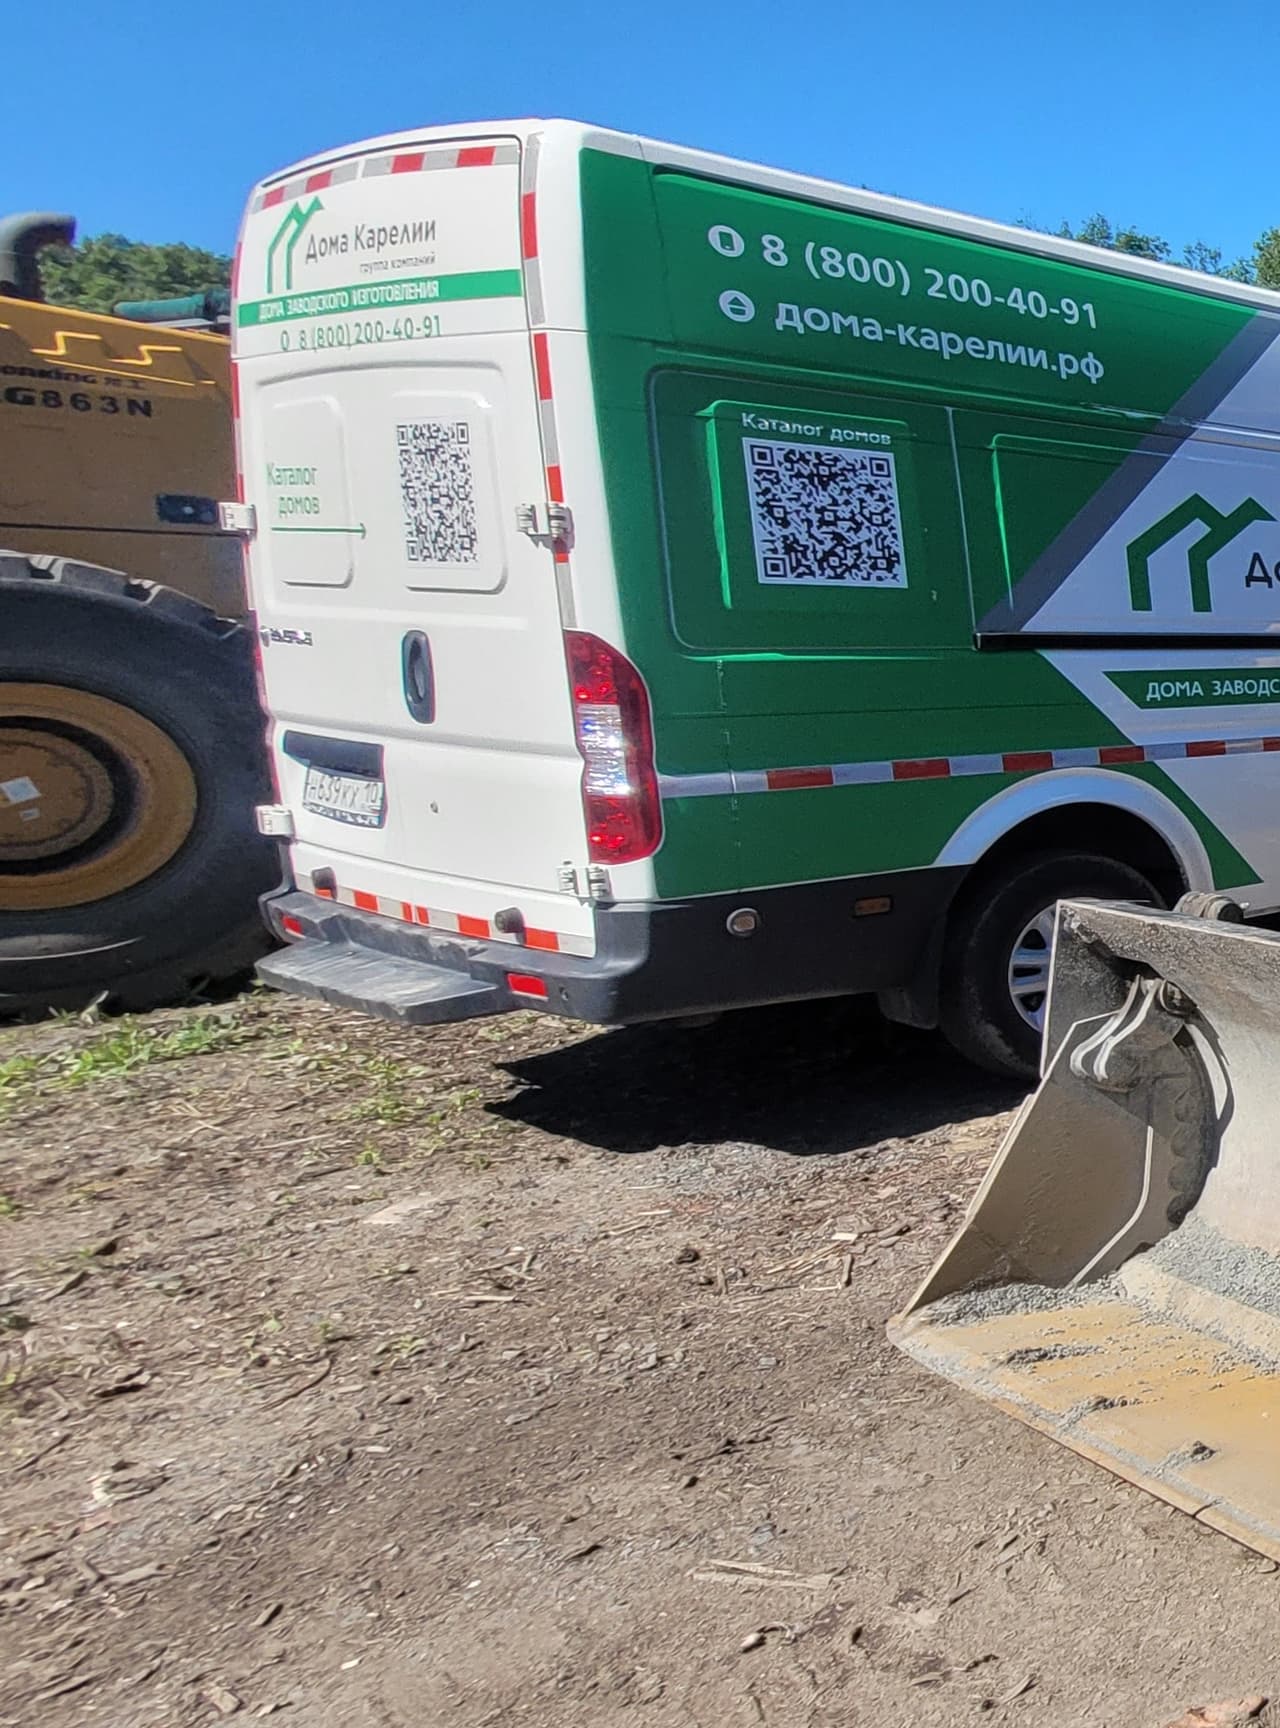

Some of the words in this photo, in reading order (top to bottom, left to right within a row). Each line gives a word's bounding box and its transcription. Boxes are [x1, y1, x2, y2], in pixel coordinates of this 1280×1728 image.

[305, 233, 349, 264] Дома
[354, 220, 436, 253] Карелии
[761, 234, 788, 267] 8
[804, 241, 911, 296] (800)
[923, 267, 1097, 329] 200-40-91
[259, 302, 285, 321] ДОМА
[287, 290, 349, 316] ЗАВОДСКОГО
[352, 280, 440, 306] ИЗГОТОВЛЕНИЯ
[354, 315, 442, 344] 200-40-91
[775, 301, 1105, 384] дома-карелии.рф
[0, 386, 152, 418] G863N
[741, 412, 824, 437] Каталог
[829, 427, 892, 446] домов
[266, 462, 317, 486] Каталог
[278, 496, 320, 518] домов
[1146, 680, 1206, 701] ДОМА
